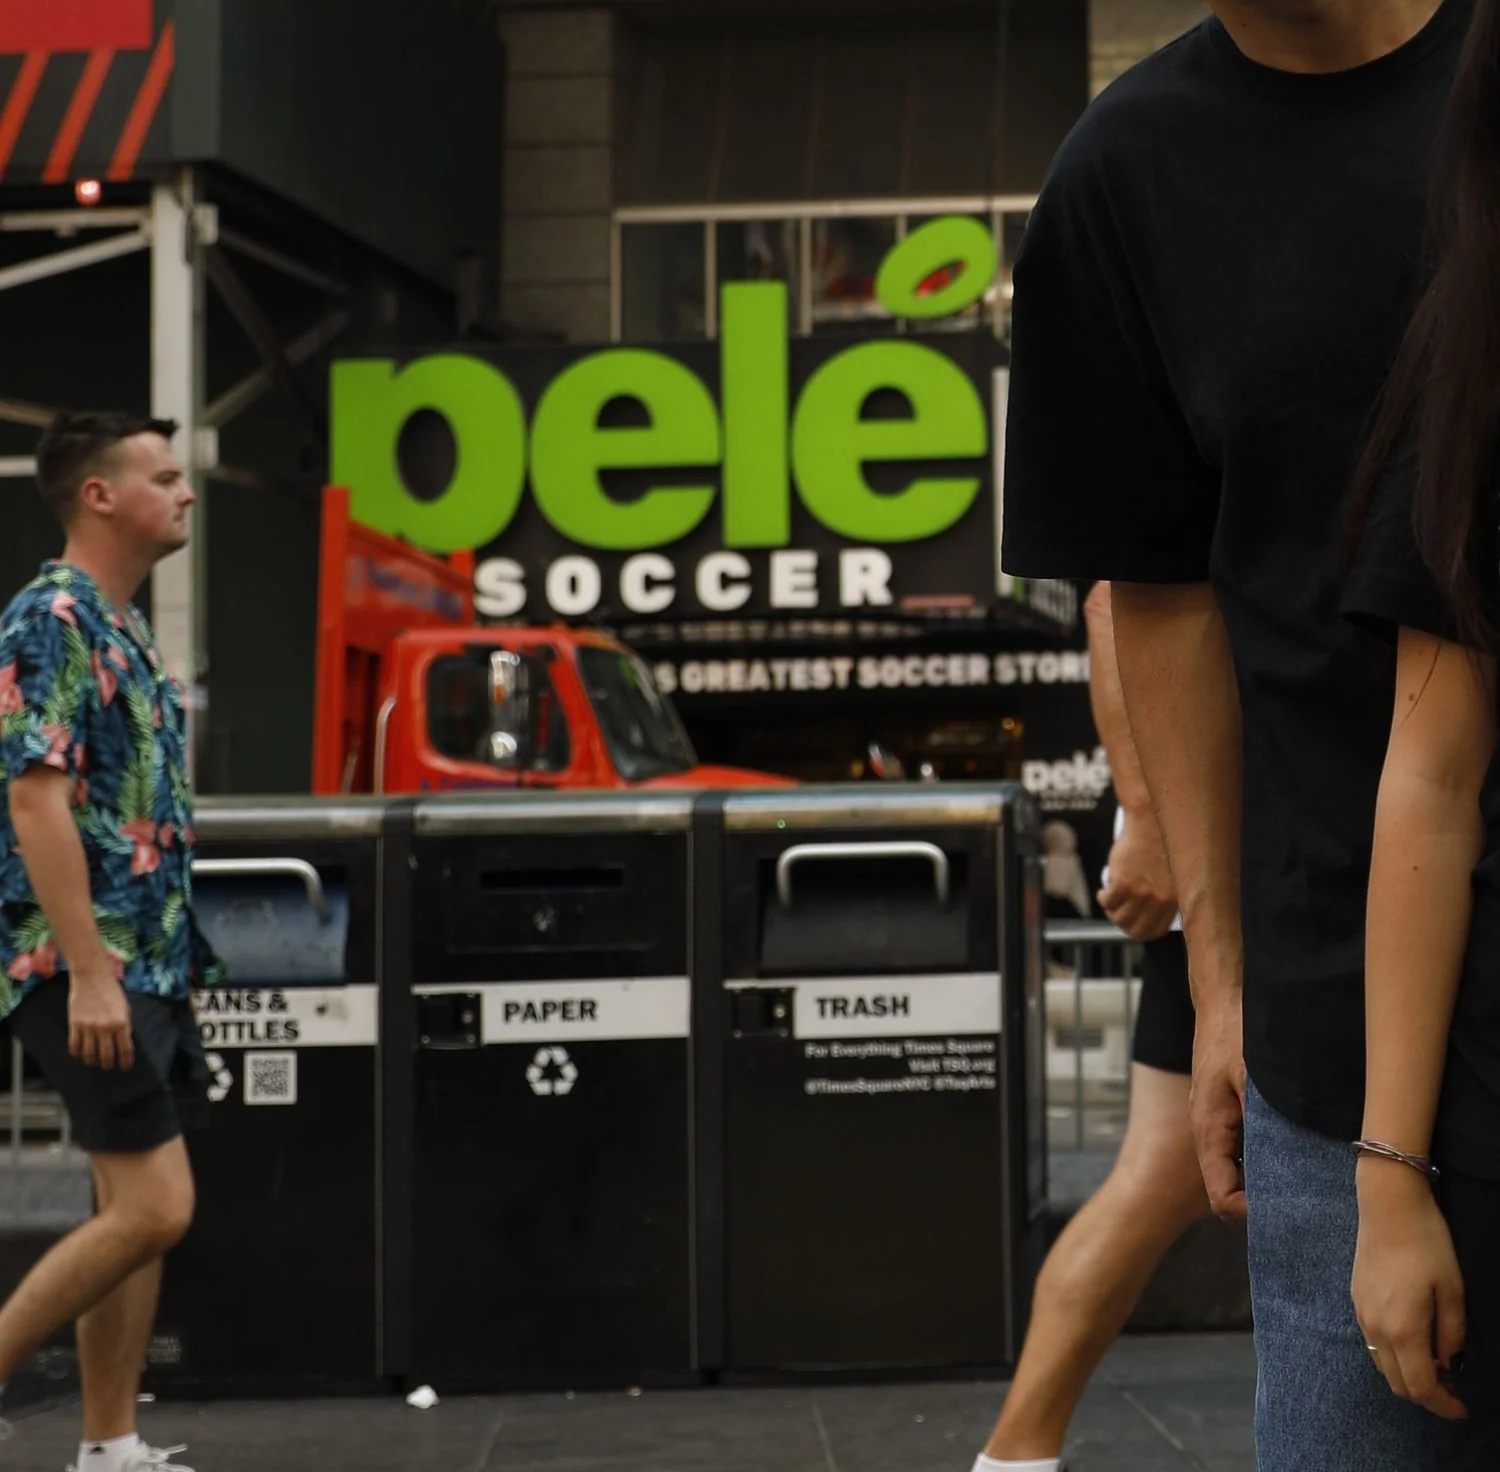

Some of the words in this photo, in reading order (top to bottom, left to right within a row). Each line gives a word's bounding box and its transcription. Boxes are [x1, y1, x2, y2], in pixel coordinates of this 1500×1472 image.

[330, 215, 997, 552] pelé
[474, 548, 893, 617] SOCCER
[681, 657, 853, 692] GREATEST
[857, 654, 991, 687] SOCCER
[994, 650, 1091, 684] STOR
[503, 1000, 598, 1024] PAPER
[815, 996, 911, 1019] TRASH
[199, 1021, 299, 1043] OTTLES
